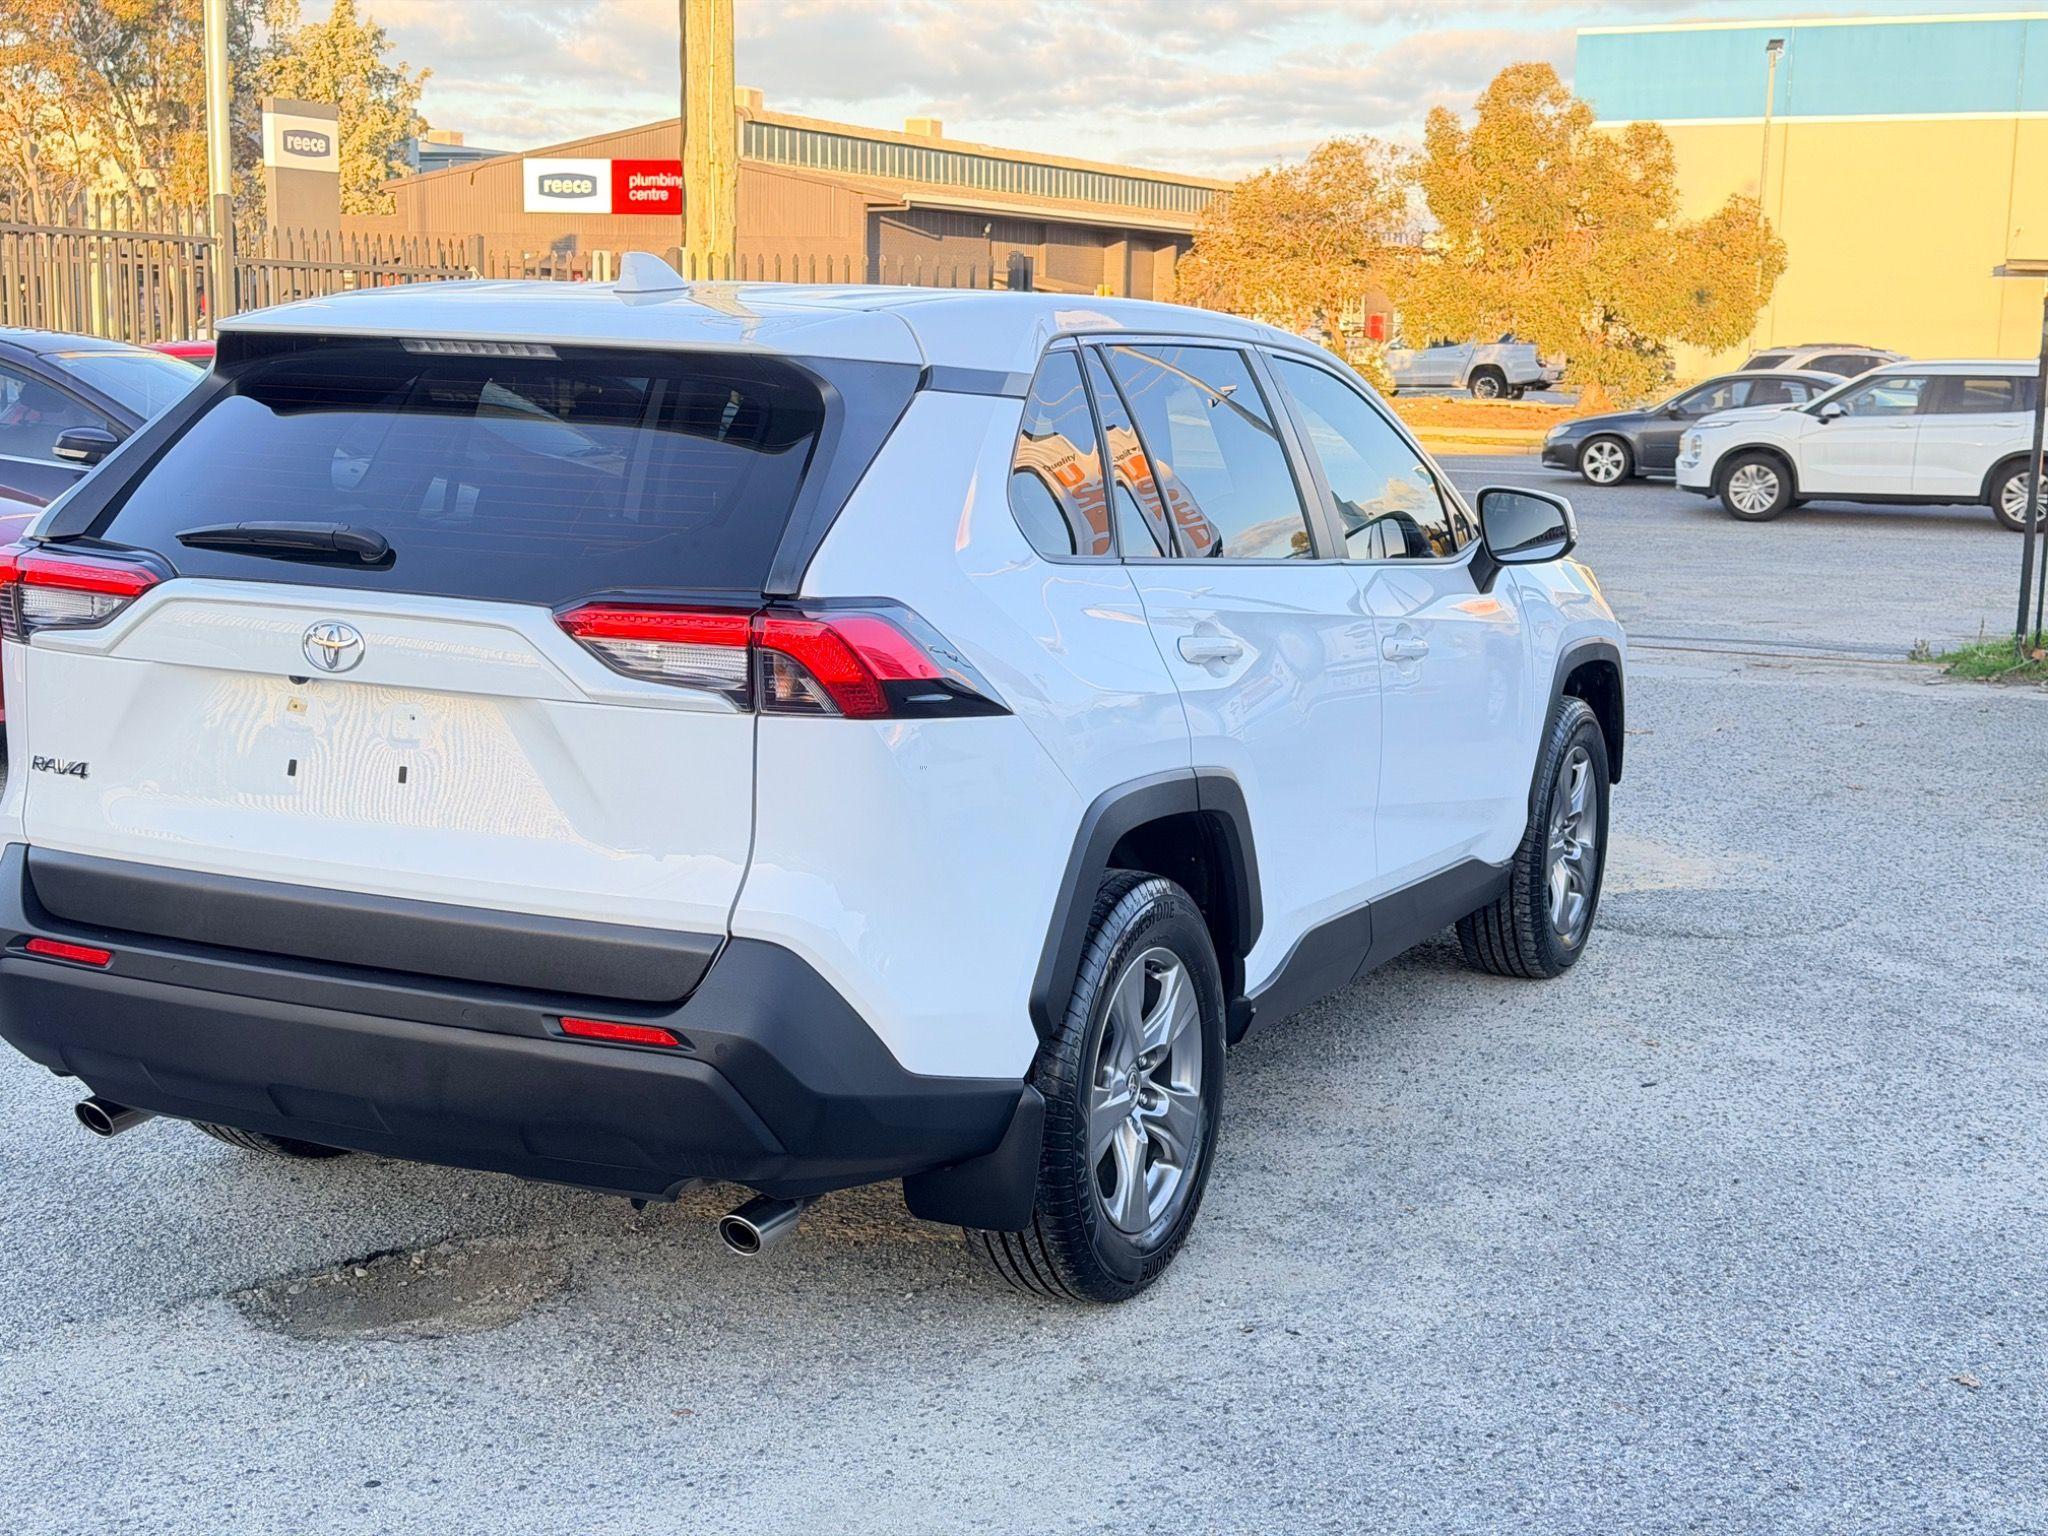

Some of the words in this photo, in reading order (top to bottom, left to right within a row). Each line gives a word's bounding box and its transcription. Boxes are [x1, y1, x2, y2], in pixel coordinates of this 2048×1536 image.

[286, 135, 326, 153] reece
[543, 179, 593, 194] reece
[629, 188, 669, 201] centre
[1042, 453, 1077, 473] Quality
[32, 755, 89, 779] RAV4
[1075, 1127, 1096, 1226] ALENZA
